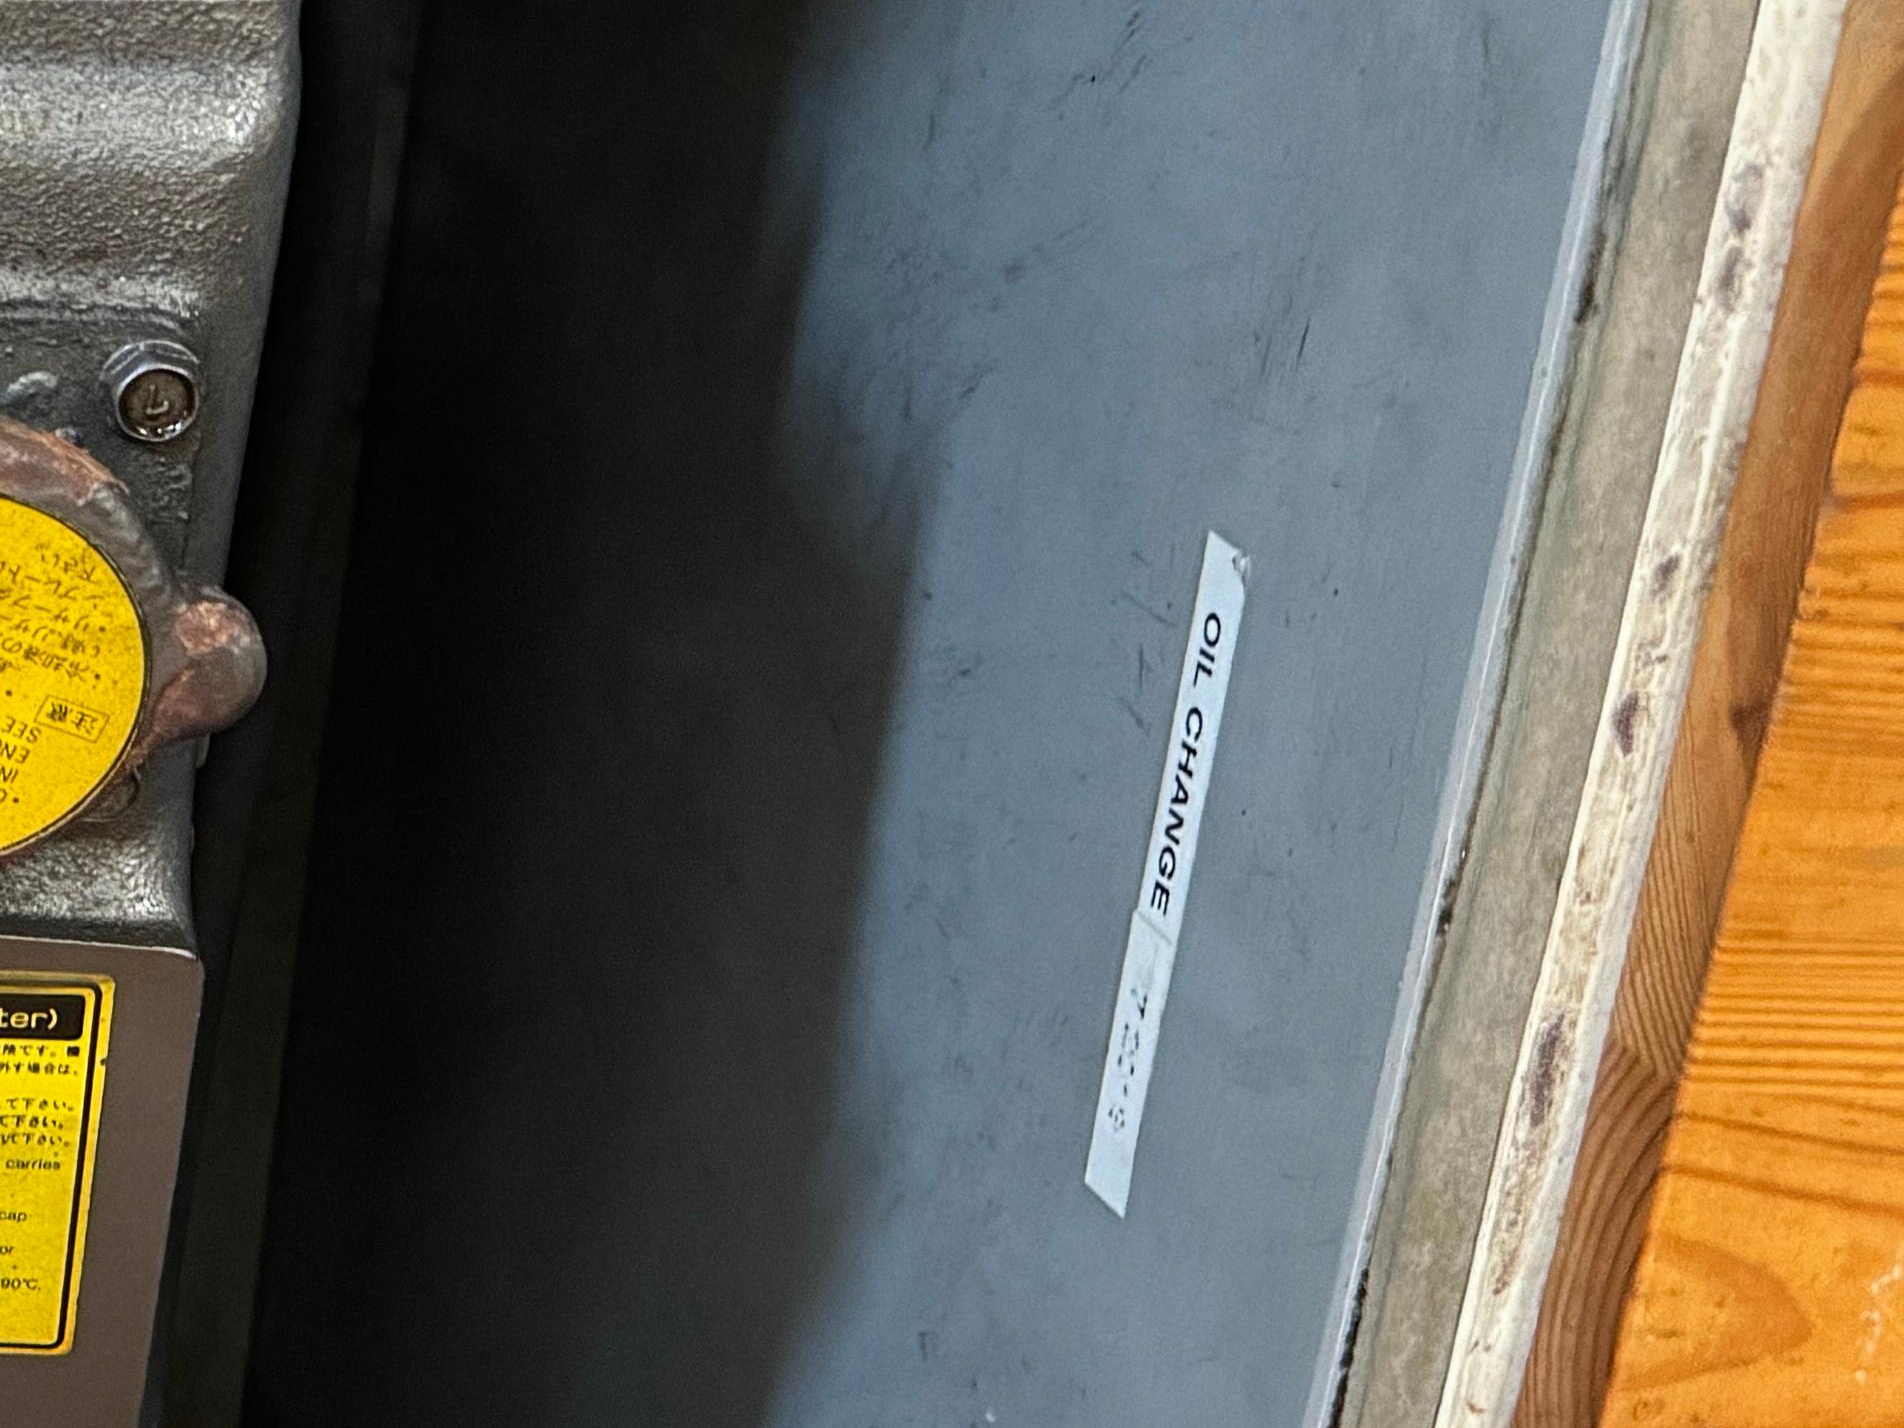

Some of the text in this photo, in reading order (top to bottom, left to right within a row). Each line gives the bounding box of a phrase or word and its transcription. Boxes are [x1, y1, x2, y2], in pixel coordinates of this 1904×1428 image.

[46, 700, 100, 737] 注意
[1149, 611, 1223, 918] OIL CHANGE
[5, 1157, 61, 1170] carries
